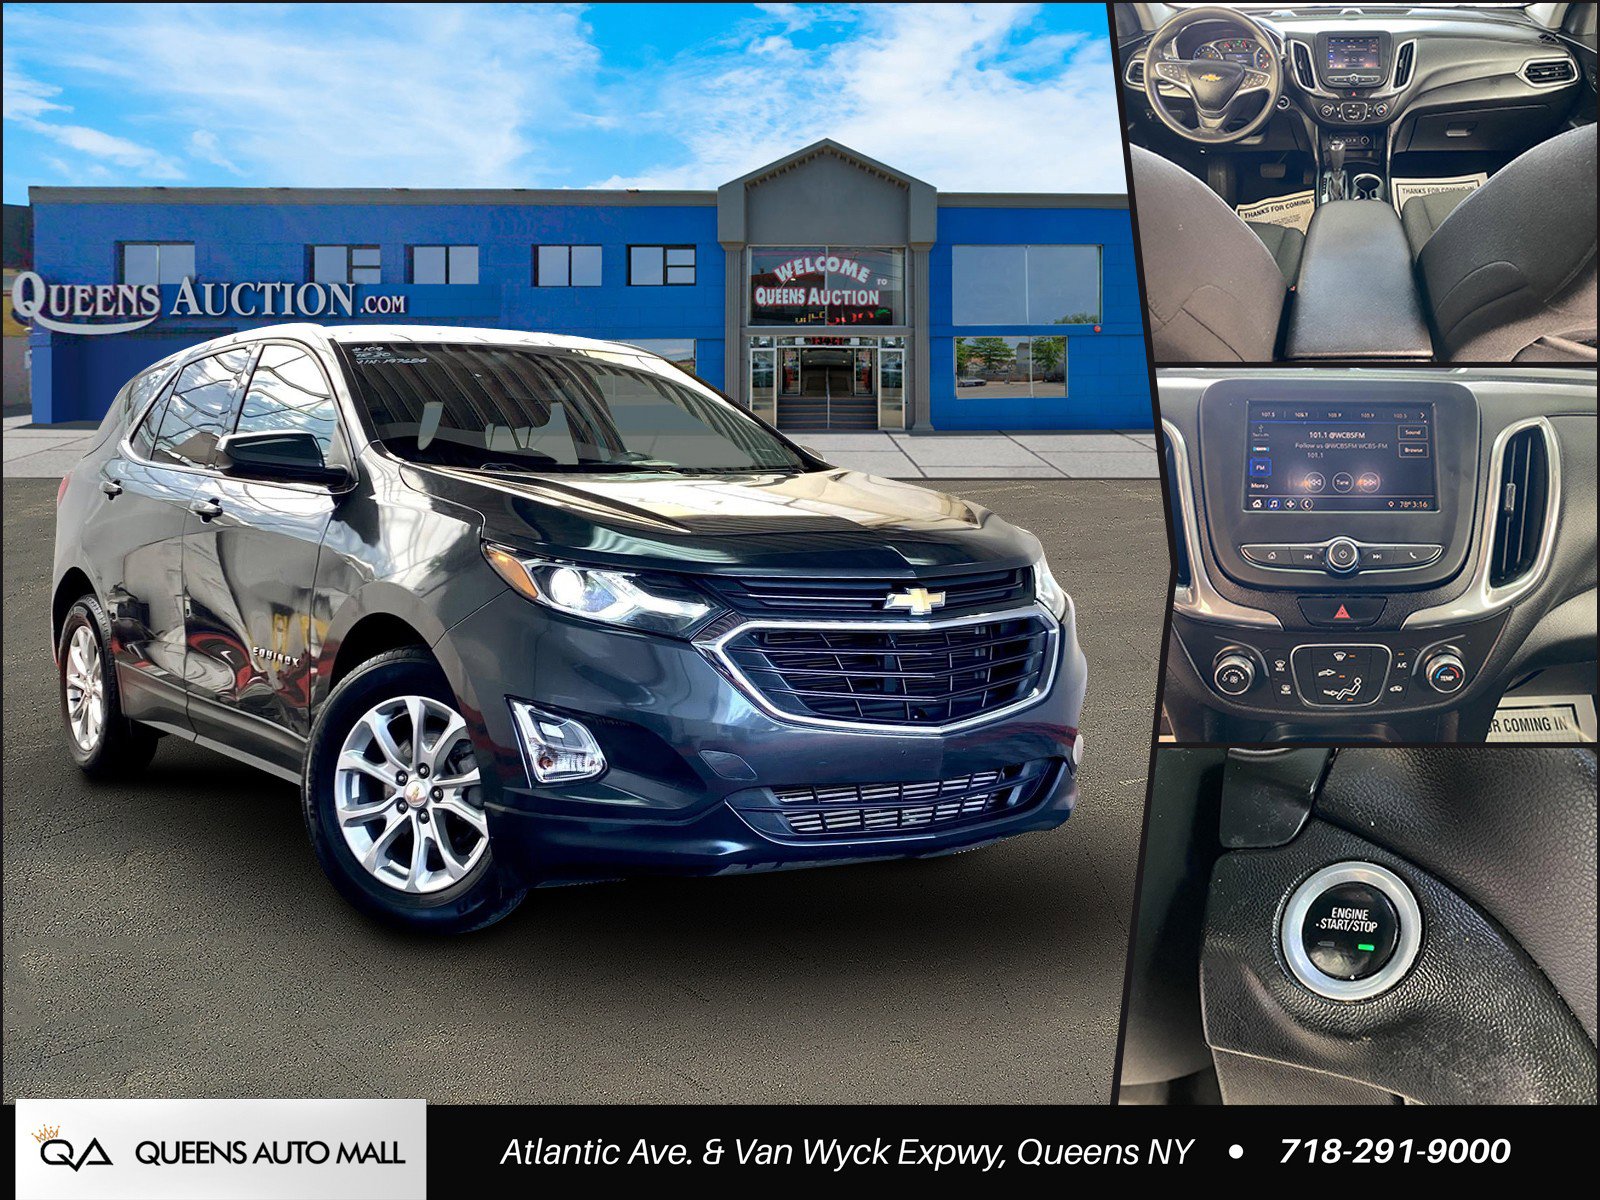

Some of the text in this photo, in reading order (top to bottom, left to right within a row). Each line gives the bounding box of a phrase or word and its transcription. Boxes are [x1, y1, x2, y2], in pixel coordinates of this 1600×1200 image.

[1402, 187, 1427, 195] THANKS
[1244, 206, 1269, 219] THANKS
[1271, 204, 1285, 213] FOR
[1286, 198, 1311, 210] COMING
[774, 256, 871, 285] WELCOME
[12, 271, 161, 334] QUEENS
[755, 286, 880, 307] QUEENS AUCTION
[1309, 431, 1327, 439] 101.1
[1412, 500, 1428, 508] 3:16
[252, 646, 300, 668] EQUINOX
[1396, 661, 1408, 669] A/C
[1503, 716, 1552, 733] COMING
[1553, 715, 1569, 732] IN
[1331, 907, 1369, 920] ENGINE
